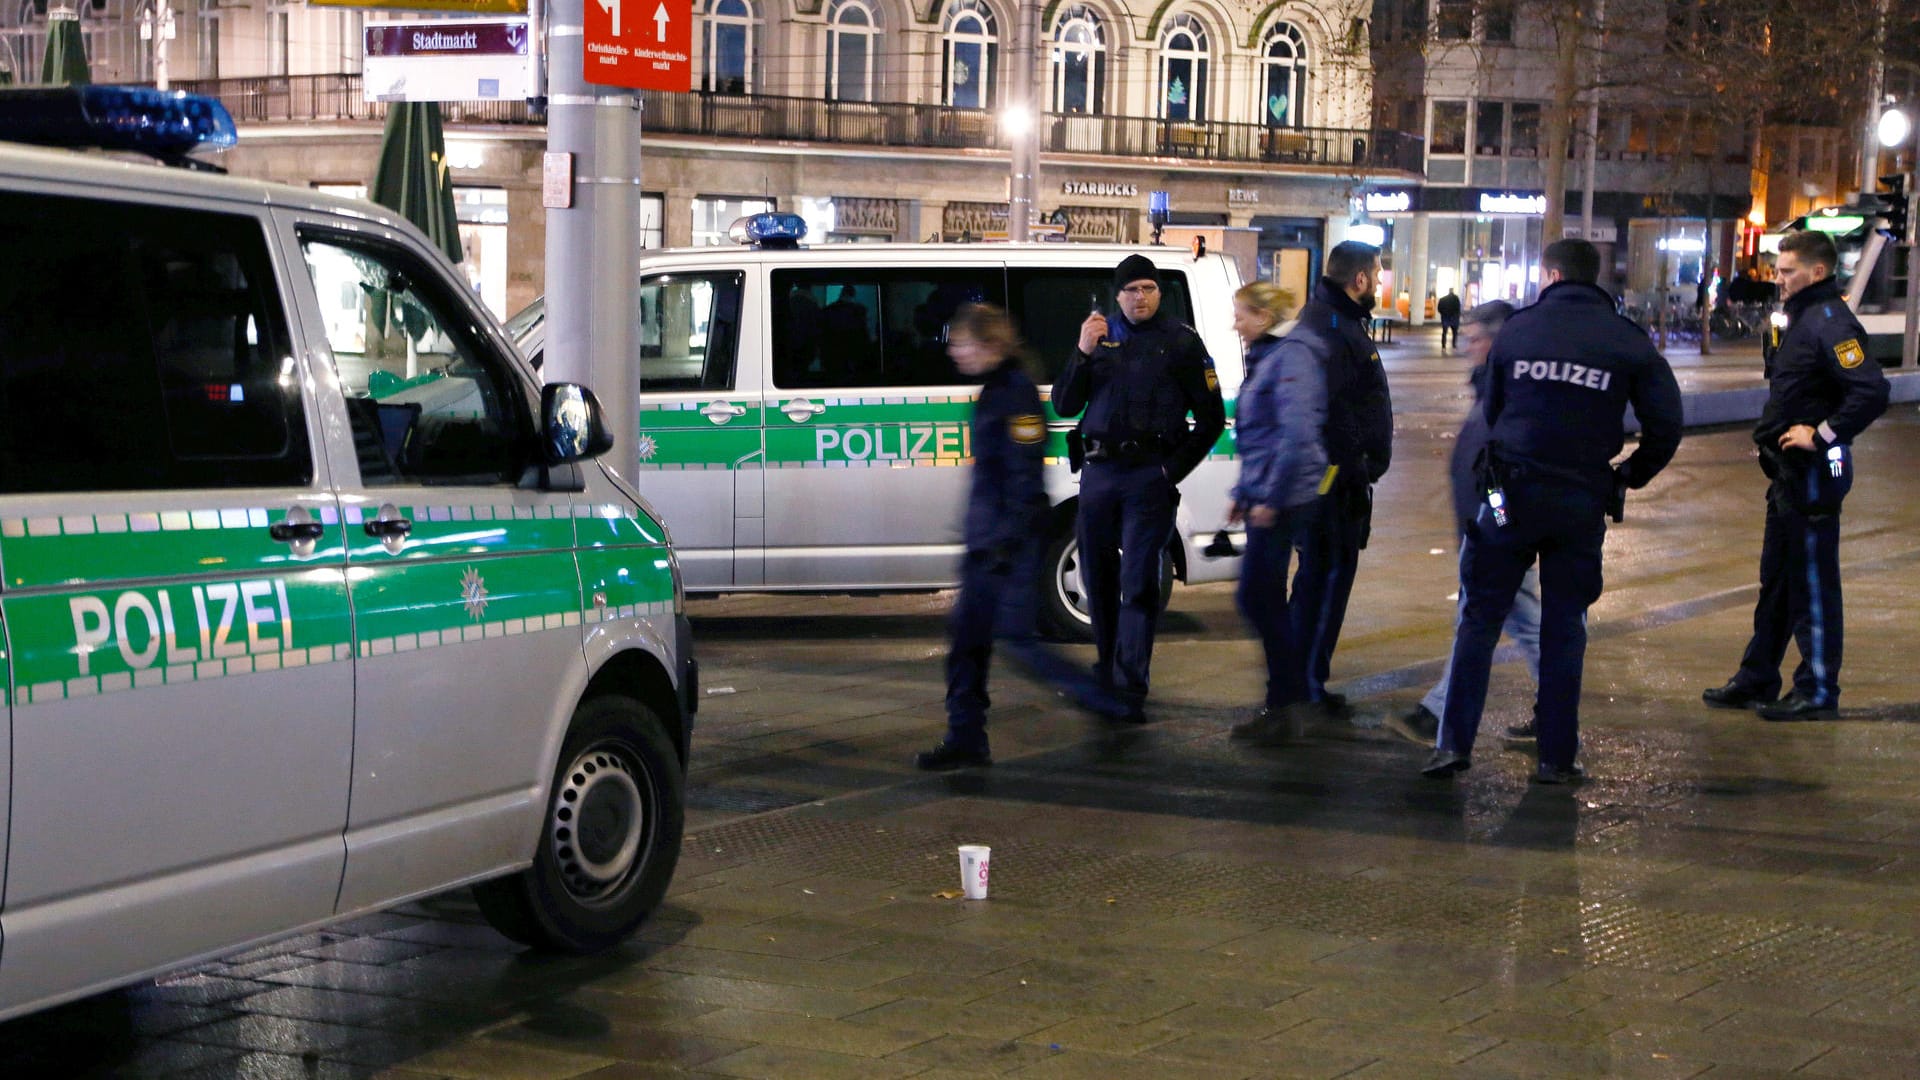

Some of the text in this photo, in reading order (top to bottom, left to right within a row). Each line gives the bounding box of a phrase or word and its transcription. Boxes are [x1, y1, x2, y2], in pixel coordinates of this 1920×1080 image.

[413, 31, 478, 50] Stadtmarkt
[599, 56, 618, 66] markt
[652, 61, 671, 71] markt
[1064, 181, 1138, 197] STARBUCKS
[1513, 360, 1612, 392] POLIZEI
[815, 426, 971, 461] POLIZEI
[69, 578, 293, 677] POLIZEI
